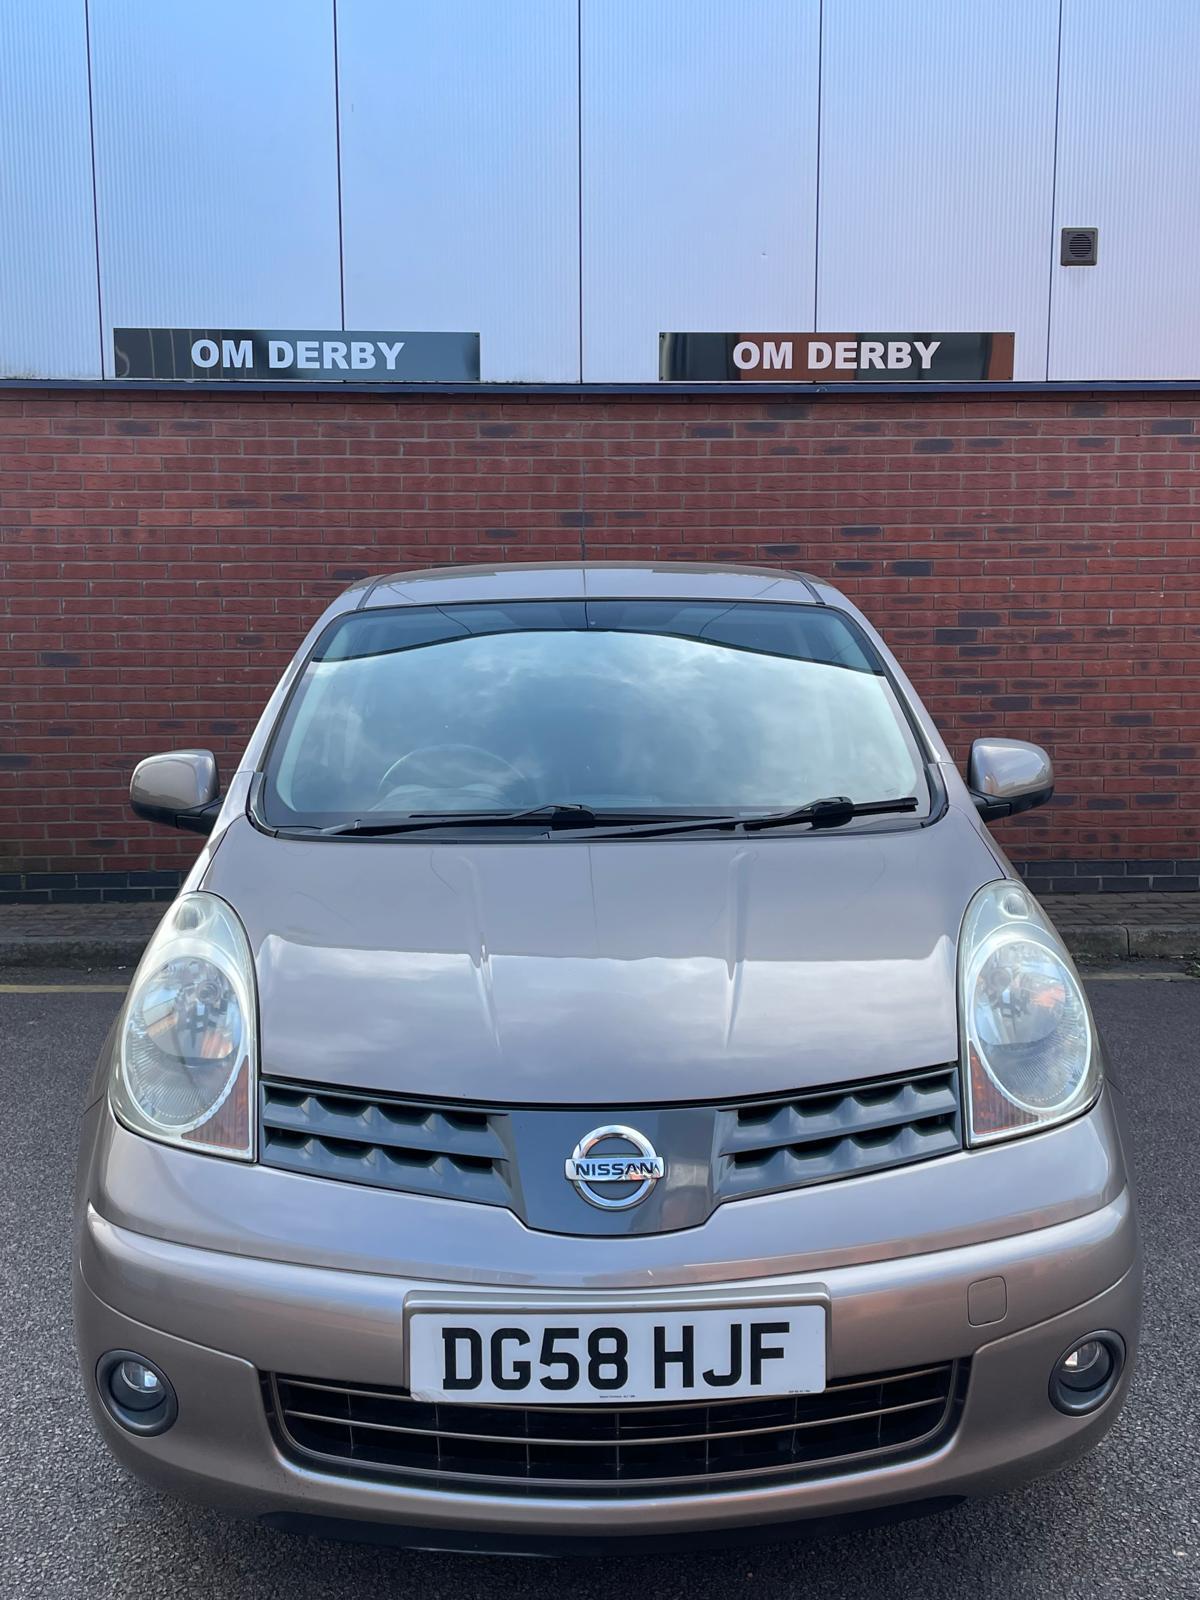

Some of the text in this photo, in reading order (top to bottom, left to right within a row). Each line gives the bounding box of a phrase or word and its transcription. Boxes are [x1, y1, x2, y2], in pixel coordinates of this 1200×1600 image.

[190, 339, 406, 370] OM DERBY
[732, 341, 942, 370] OM DERBY
[575, 1161, 654, 1176] NISSAN
[441, 1321, 790, 1391] DG58 HJF
